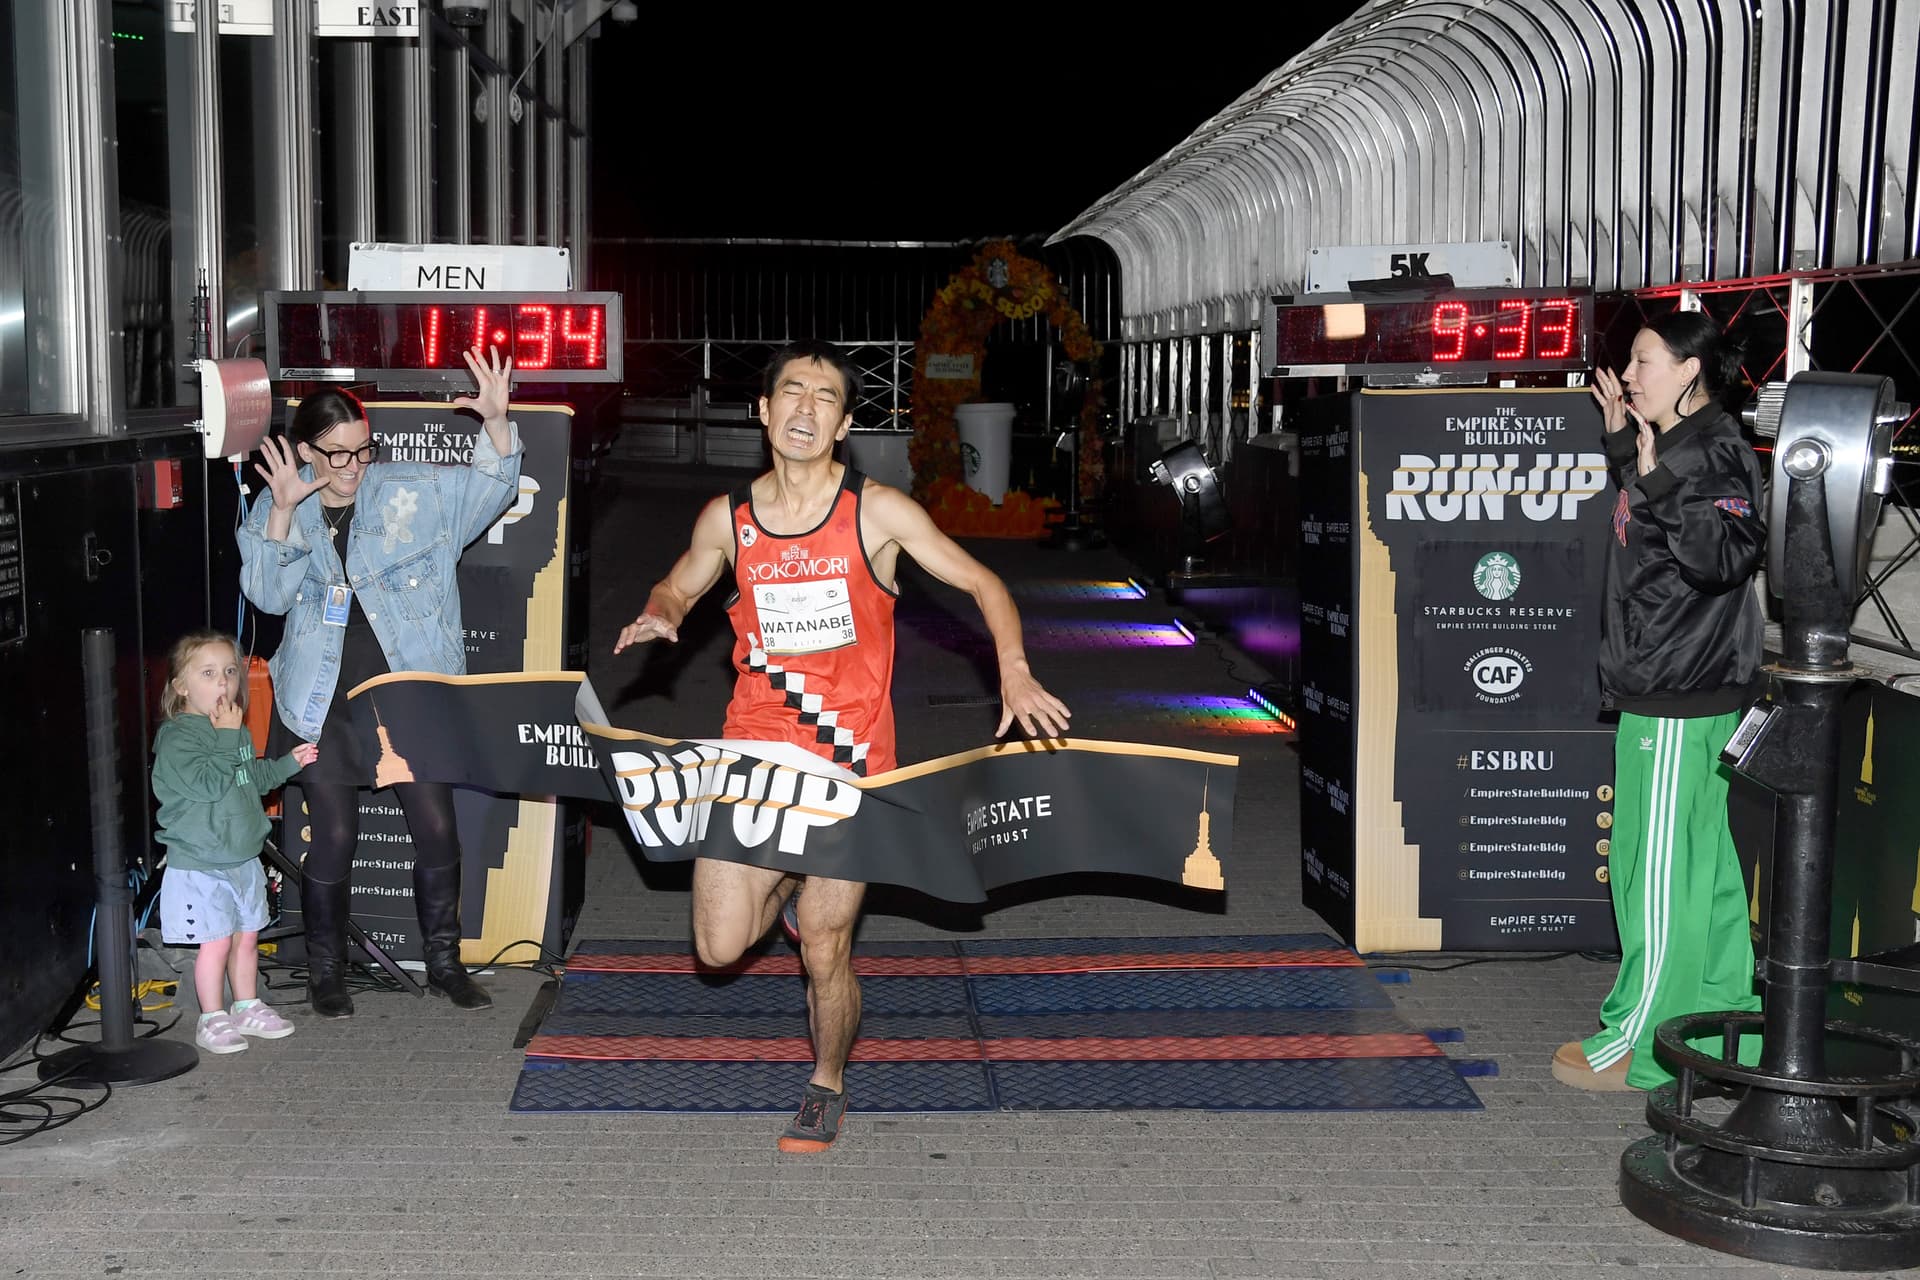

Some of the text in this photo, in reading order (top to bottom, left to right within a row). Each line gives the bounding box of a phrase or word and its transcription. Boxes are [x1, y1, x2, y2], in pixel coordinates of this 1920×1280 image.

[357, 6, 416, 26] EAST
[1390, 252, 1430, 277] 5K
[417, 265, 485, 290] MEN
[1495, 407, 1517, 417] THE
[423, 423, 446, 433] THE
[1445, 416, 1566, 432] EMPIRE STATE
[372, 432, 438, 448] EMPIRE
[1463, 431, 1547, 446] BUILDING
[391, 447, 475, 464] BUILDING
[1385, 453, 1609, 522] RUN-UP
[748, 557, 849, 582] YOKOMORI
[1424, 606, 1574, 617] STARBUCKS RESERVE
[761, 614, 853, 634] WATANABE
[1436, 622, 1464, 630] EMPIRE
[1467, 622, 1489, 630] STATE
[1533, 623, 1557, 631] STORE
[461, 629, 497, 641] ERVE
[842, 628, 854, 640] 38
[764, 636, 776, 648] 38
[1464, 646, 1533, 673] CHALLENGED ATHLETES
[1477, 666, 1518, 684] CAF
[1475, 692, 1521, 704] FOUNDATION
[517, 723, 591, 747] EMPIR
[1456, 750, 1554, 771] #ESBRU
[1463, 788, 1590, 799] /EmpireStateBuilding
[990, 795, 1052, 825] STATE
[1458, 815, 1567, 827] @EmpireStateBldg
[990, 828, 1029, 847] TRUST
[1458, 842, 1566, 853] @EmpireStateBldg
[1458, 869, 1566, 881] @EmpireStateBldg
[1490, 915, 1576, 926] EMPIRE STATE
[371, 931, 406, 944] STATE
